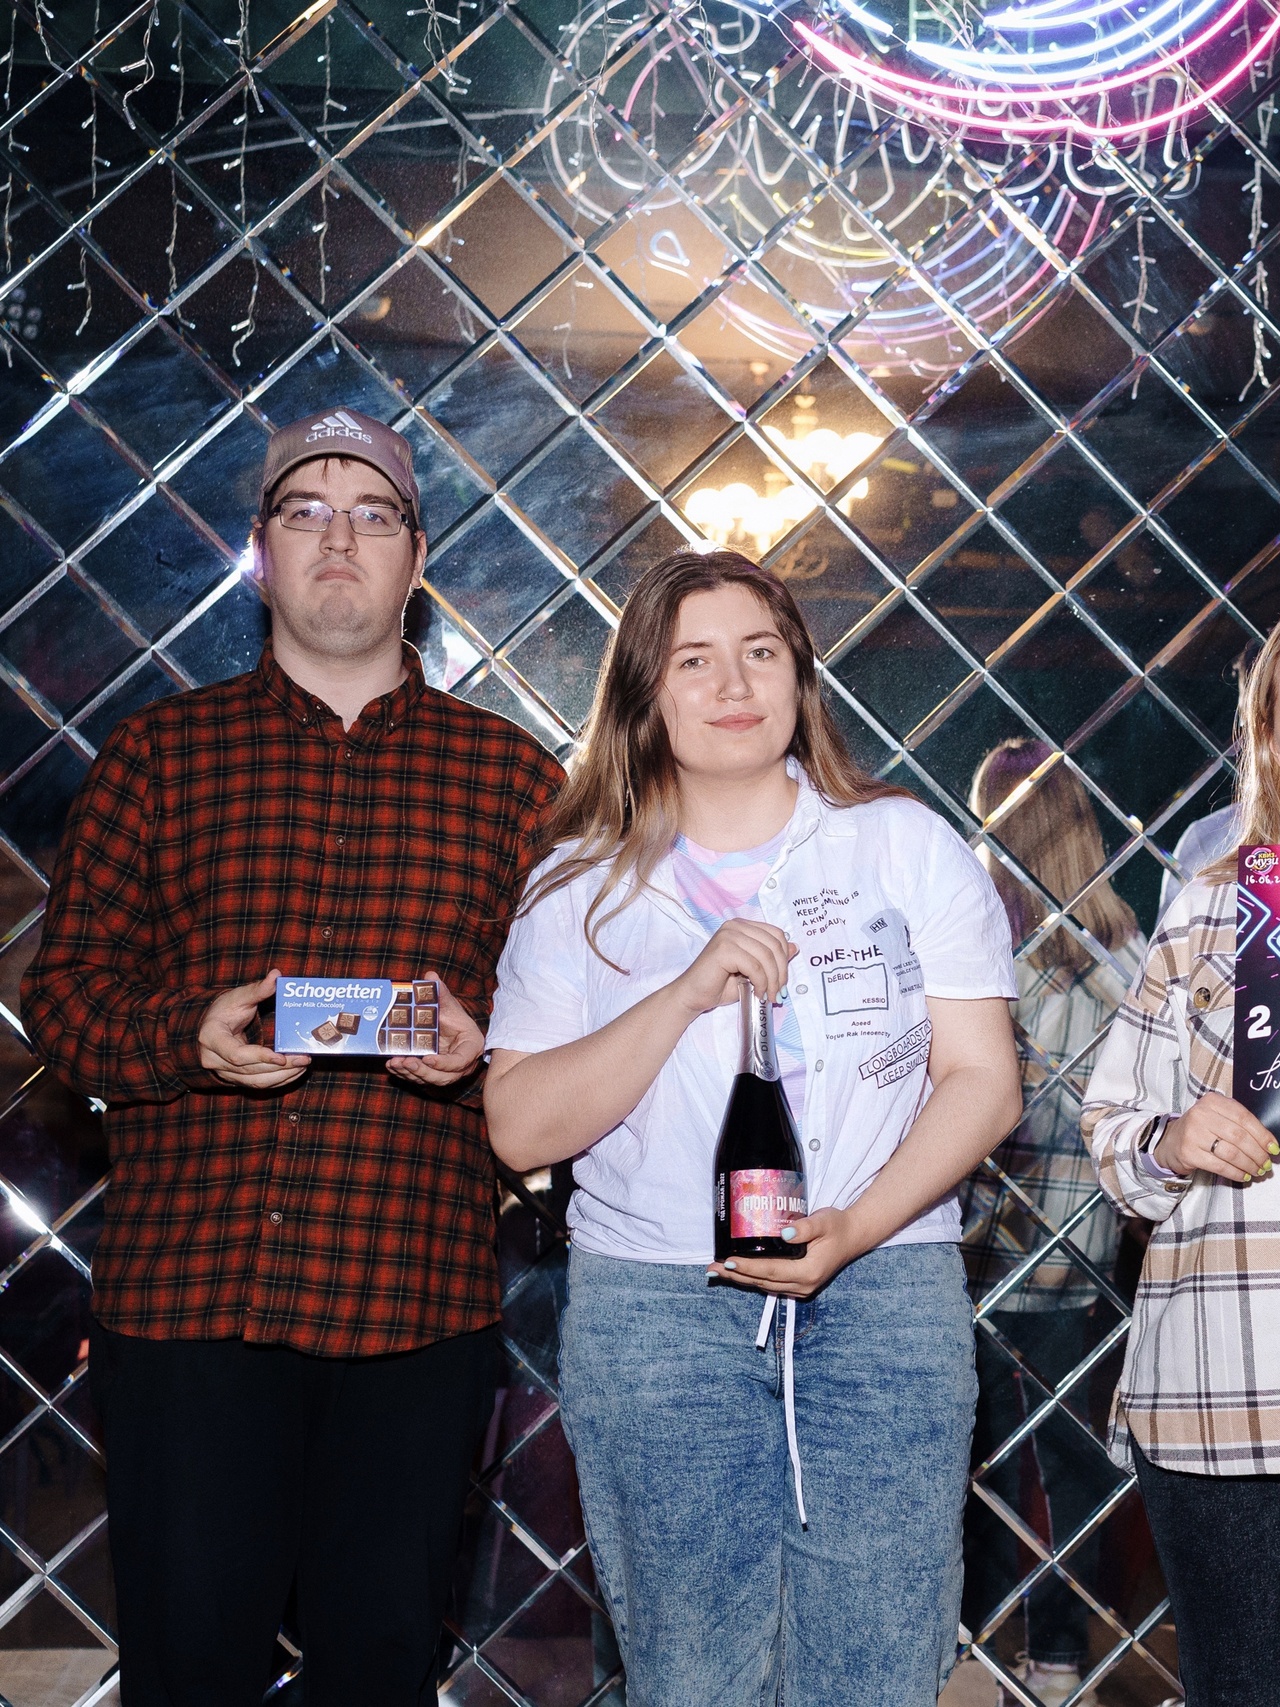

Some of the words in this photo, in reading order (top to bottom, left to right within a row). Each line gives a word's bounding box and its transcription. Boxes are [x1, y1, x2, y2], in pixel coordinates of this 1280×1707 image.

[305, 427, 373, 444] adidas
[1245, 854, 1279, 868] Смузи
[792, 895, 819, 907] WHITE
[796, 906, 819, 917] KEEP
[851, 890, 860, 900] IS
[806, 928, 817, 937] OF
[283, 981, 382, 1003] Schogetten
[283, 1001, 302, 1009] Alpine
[316, 1001, 345, 1009] Chocolate
[1247, 1004, 1272, 1040] 2
[882, 1065, 905, 1084] KEEP
[776, 1196, 788, 1212] DI
